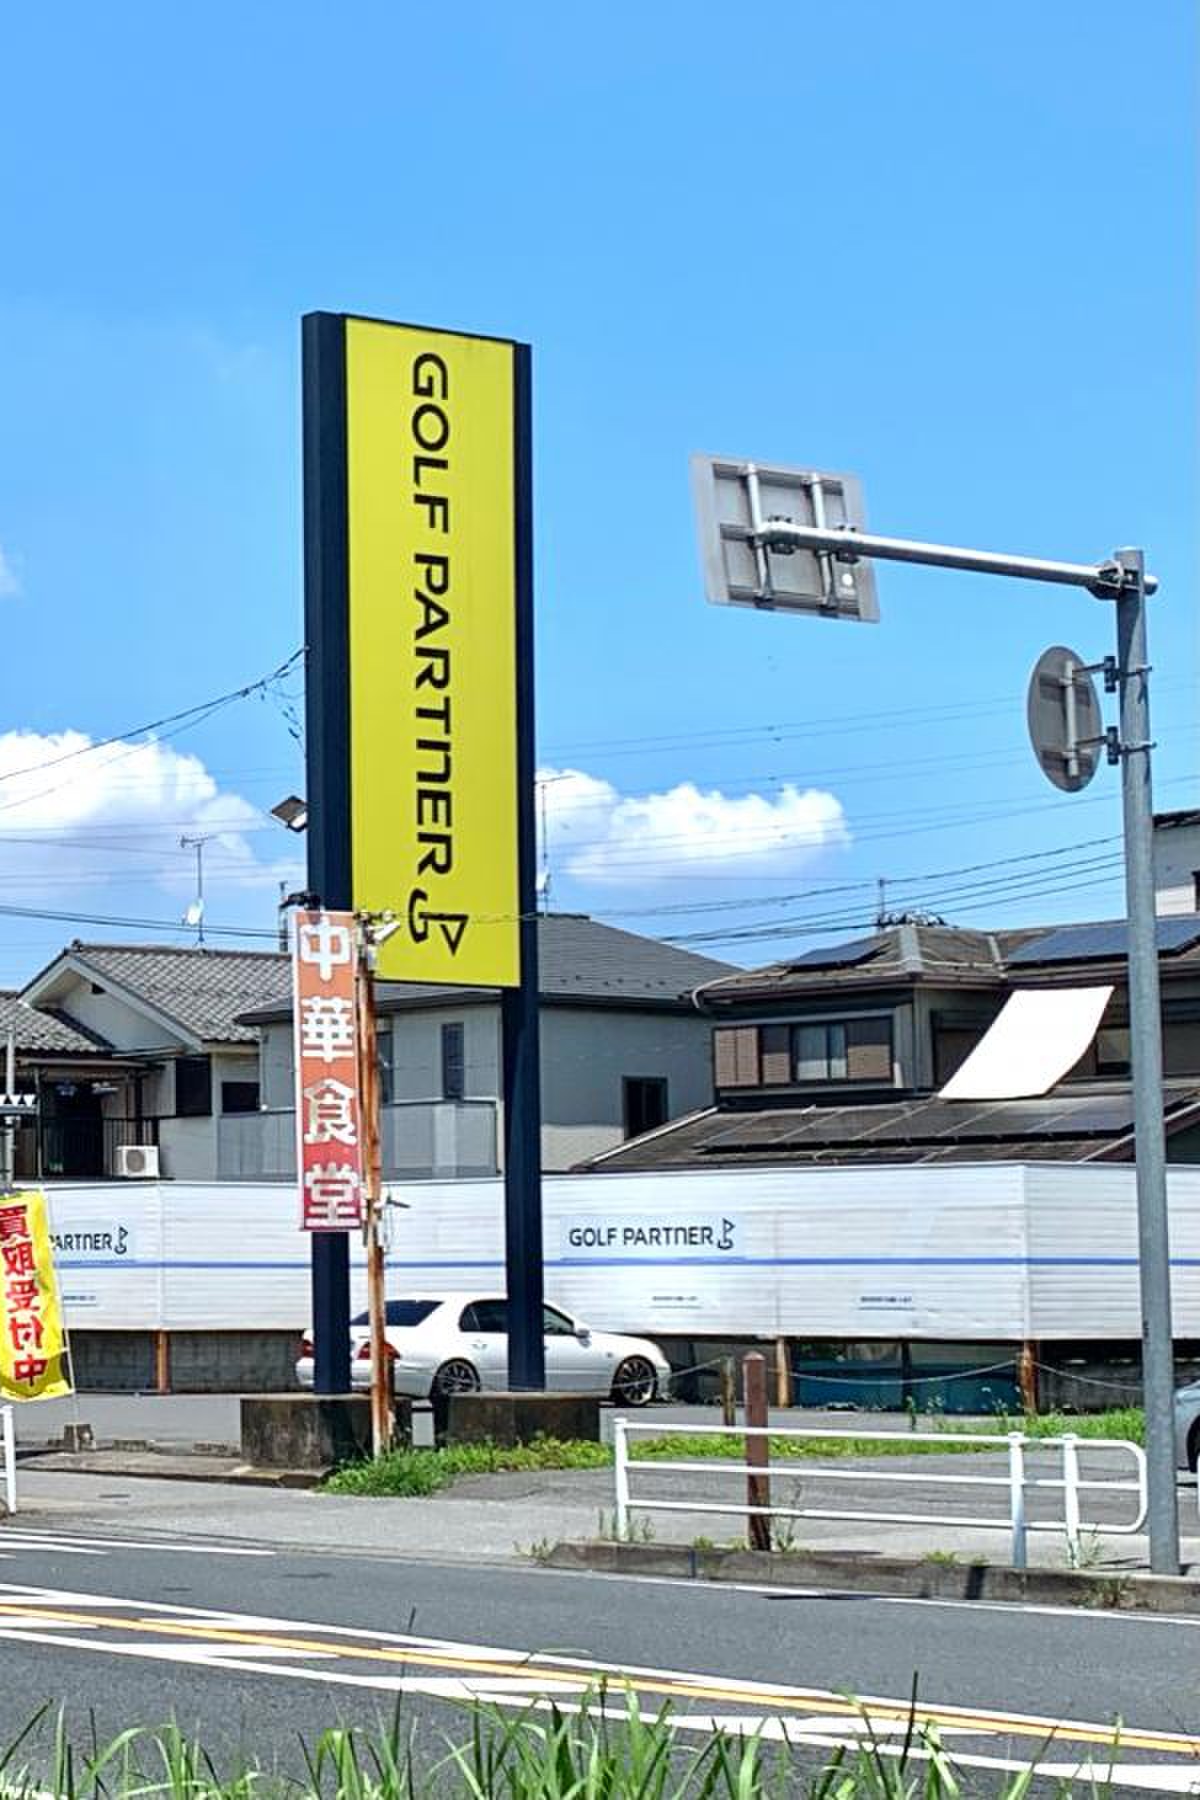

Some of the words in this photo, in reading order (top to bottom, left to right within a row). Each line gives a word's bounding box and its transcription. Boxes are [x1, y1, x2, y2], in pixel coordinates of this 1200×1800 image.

[411, 352, 450, 534] GOLF
[413, 553, 453, 875] PARTNER
[300, 916, 360, 1228] 中華食堂
[569, 1227, 617, 1247] GOLF
[623, 1226, 714, 1245] PARTNER
